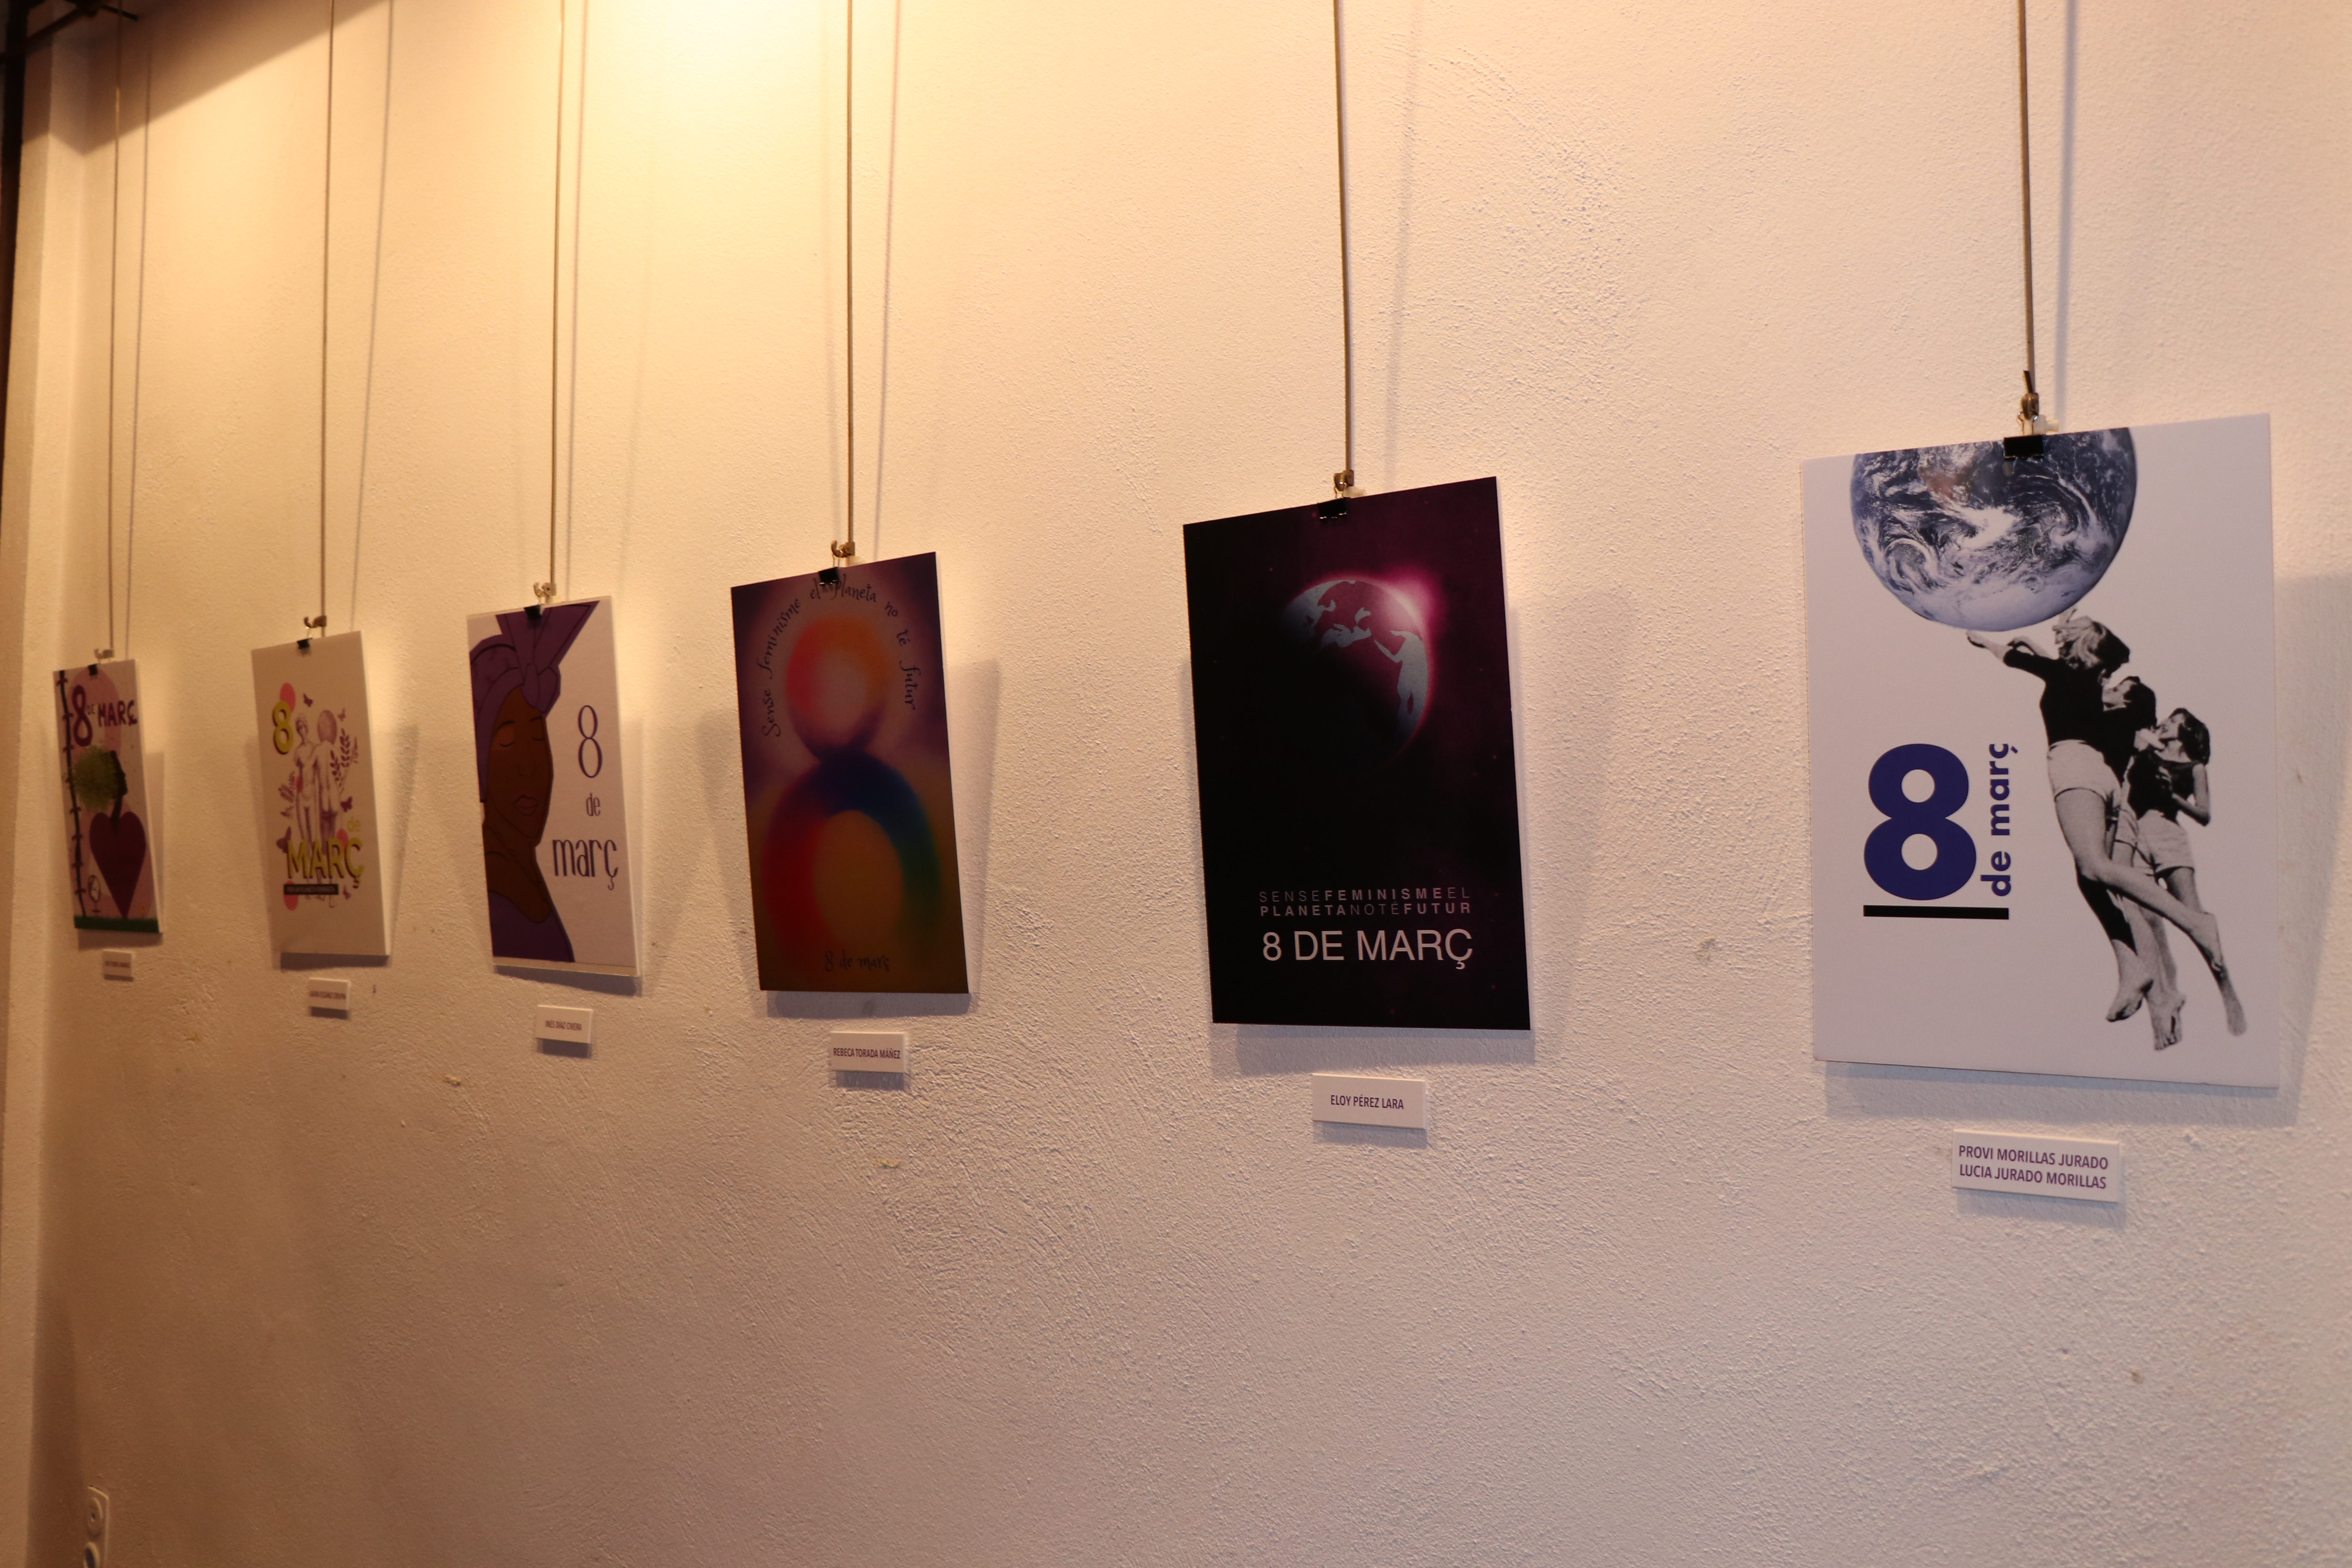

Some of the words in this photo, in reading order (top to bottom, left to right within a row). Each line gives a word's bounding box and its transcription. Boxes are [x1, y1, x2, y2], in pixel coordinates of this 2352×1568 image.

[810, 578, 821, 600] el
[831, 573, 877, 602] planeta
[885, 601, 898, 617] no
[757, 598, 800, 679] feminisme
[896, 629, 911, 646] té
[899, 661, 921, 710] futur
[72, 685, 93, 746] 8
[273, 701, 294, 754] 8
[762, 689, 781, 737] Sense
[578, 705, 603, 778] 8
[586, 793, 601, 816] de
[1989, 743, 2018, 836] març
[347, 816, 361, 832] de
[1864, 743, 1977, 900] 8
[287, 837, 365, 888] MARÇ
[552, 840, 618, 890] març
[1980, 851, 2011, 897] de
[825, 951, 833, 972] 8
[840, 949, 853, 970] de
[859, 955, 889, 972] març
[1263, 932, 1282, 961] 8
[1294, 931, 1344, 960] DE
[1357, 928, 1473, 969] MARÇ
[833, 1047, 854, 1056] REBECA
[855, 1049, 878, 1058] TORADA
[880, 1048, 900, 1058] MÁÑEZ
[1331, 1095, 1351, 1106] ELOY
[1353, 1094, 1379, 1108] PÉREZ
[1382, 1098, 1404, 1109] LARA
[1959, 1145, 1993, 1159] PROVI
[1997, 1148, 2055, 1165] MORILLAS
[2058, 1154, 2108, 1169] JURADO
[1960, 1164, 1991, 1178] LUCIA
[1994, 1167, 2042, 1183] JURADO
[2046, 1172, 2106, 1189] MORILLAS
